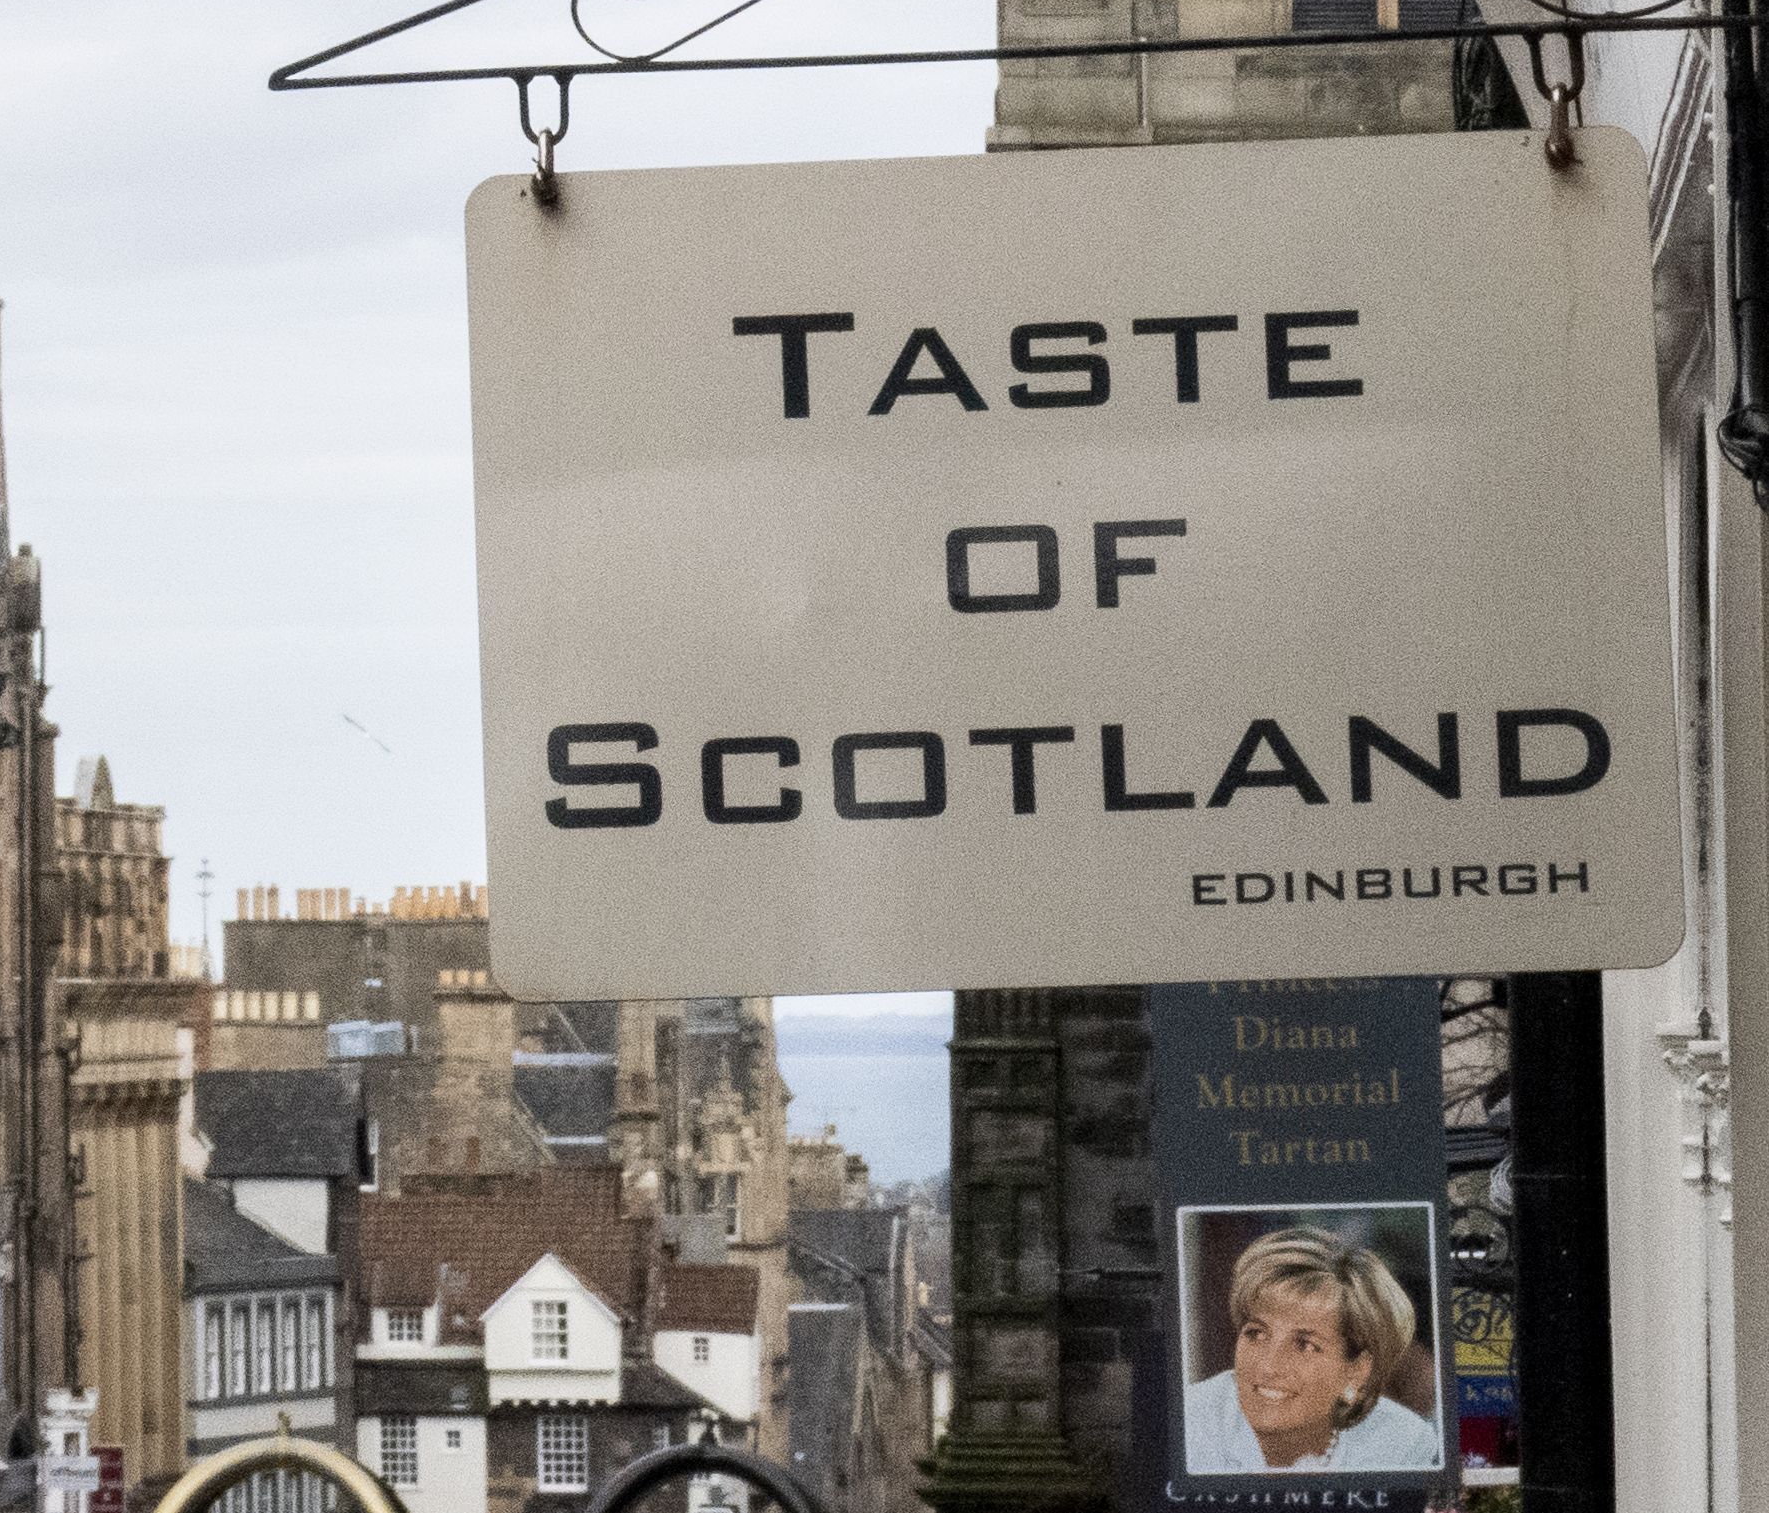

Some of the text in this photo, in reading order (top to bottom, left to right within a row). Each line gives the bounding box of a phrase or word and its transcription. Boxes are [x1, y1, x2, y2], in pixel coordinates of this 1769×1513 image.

[733, 310, 1364, 418] TASTE
[946, 521, 1186, 613] OF
[546, 708, 1612, 828] SCOTLAND
[1193, 862, 1589, 905] EDINBURGH
[1233, 1015, 1360, 1051] Diana
[1195, 1068, 1401, 1109] Memorial
[1229, 1130, 1372, 1165] Tartan
